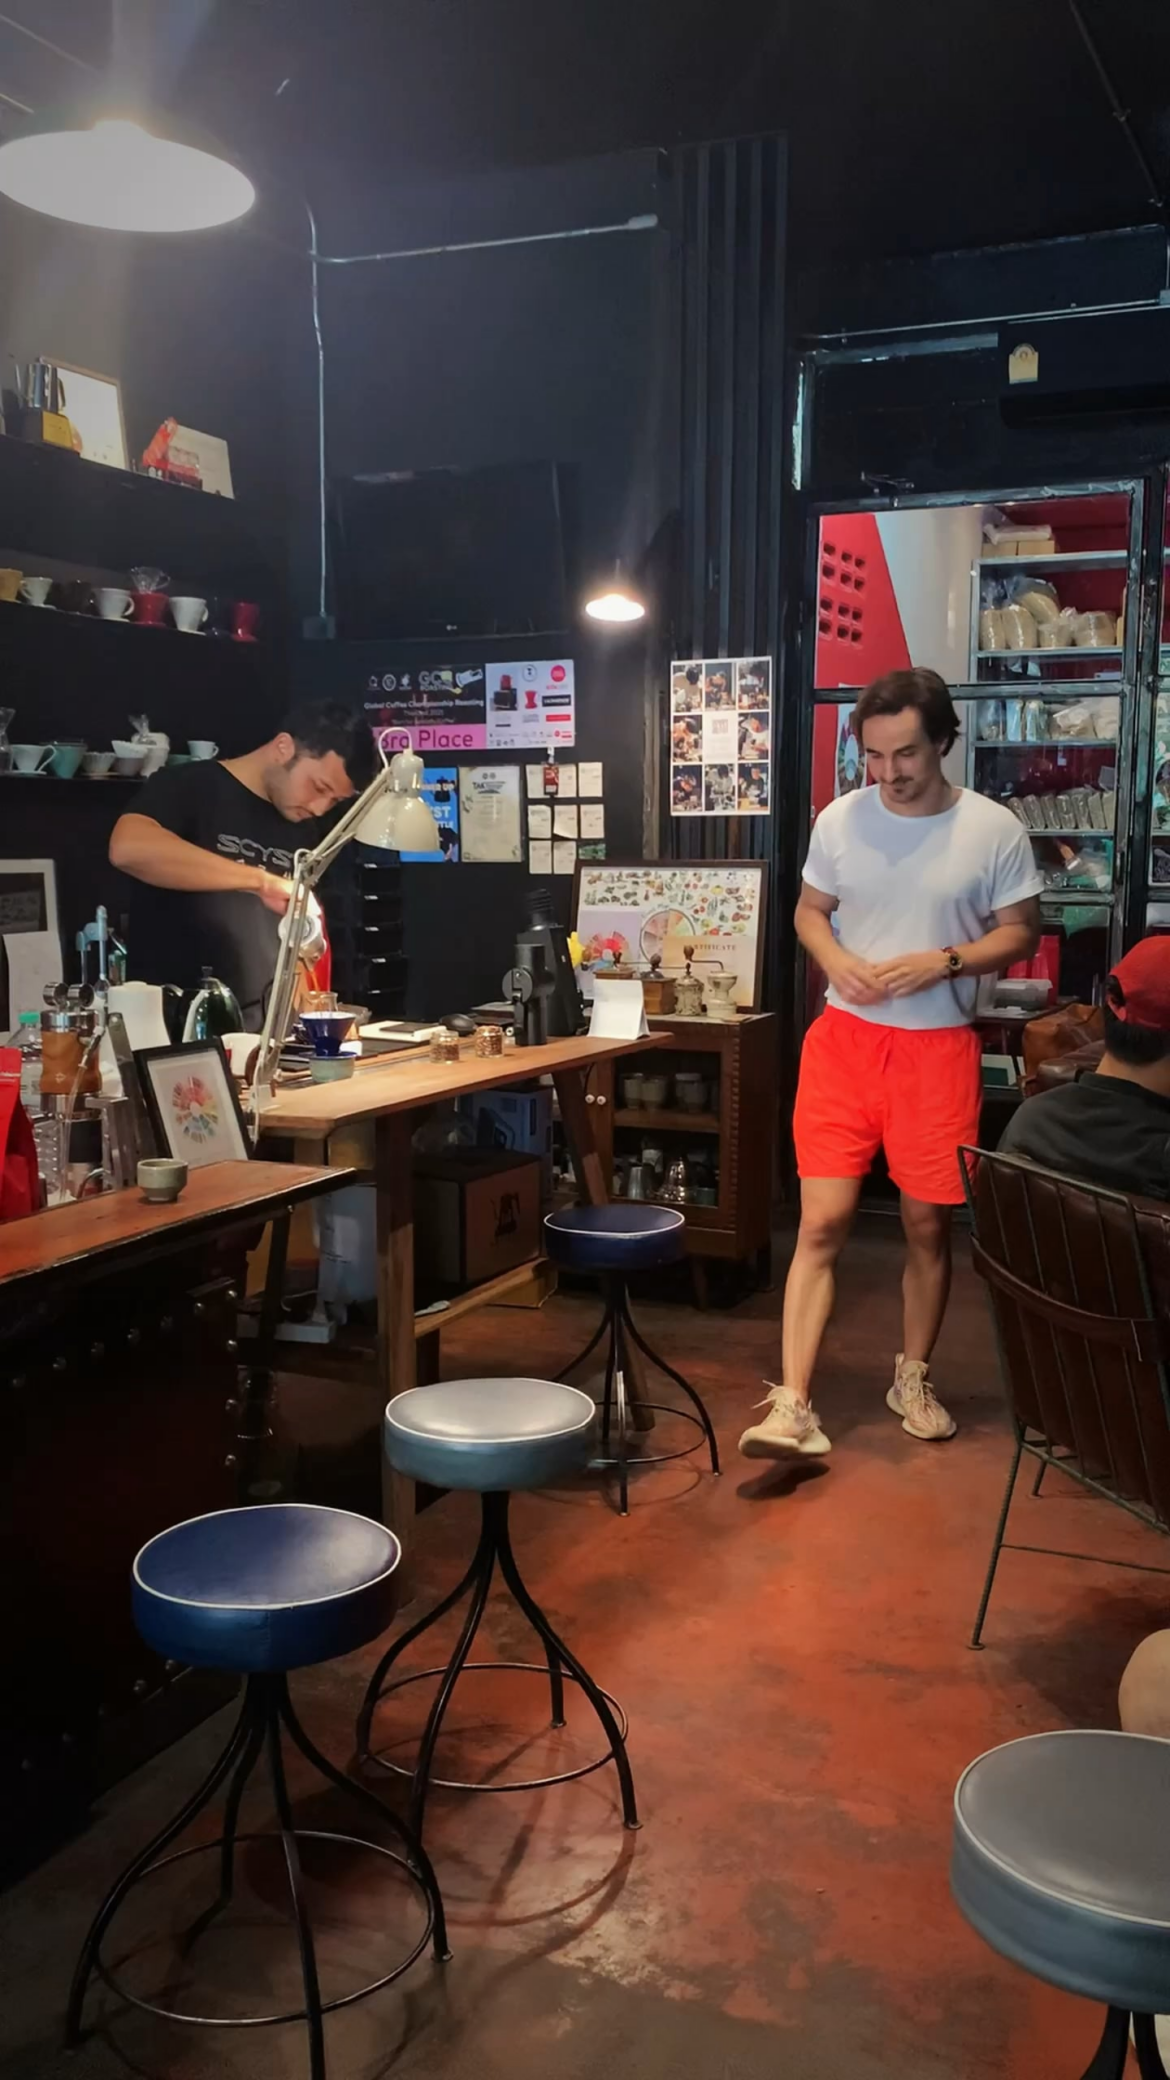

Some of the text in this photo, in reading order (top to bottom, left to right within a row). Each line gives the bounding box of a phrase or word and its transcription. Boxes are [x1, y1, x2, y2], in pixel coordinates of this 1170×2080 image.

[364, 701, 385, 710] Global
[386, 701, 407, 709] Coffee
[418, 729, 474, 748] Place
